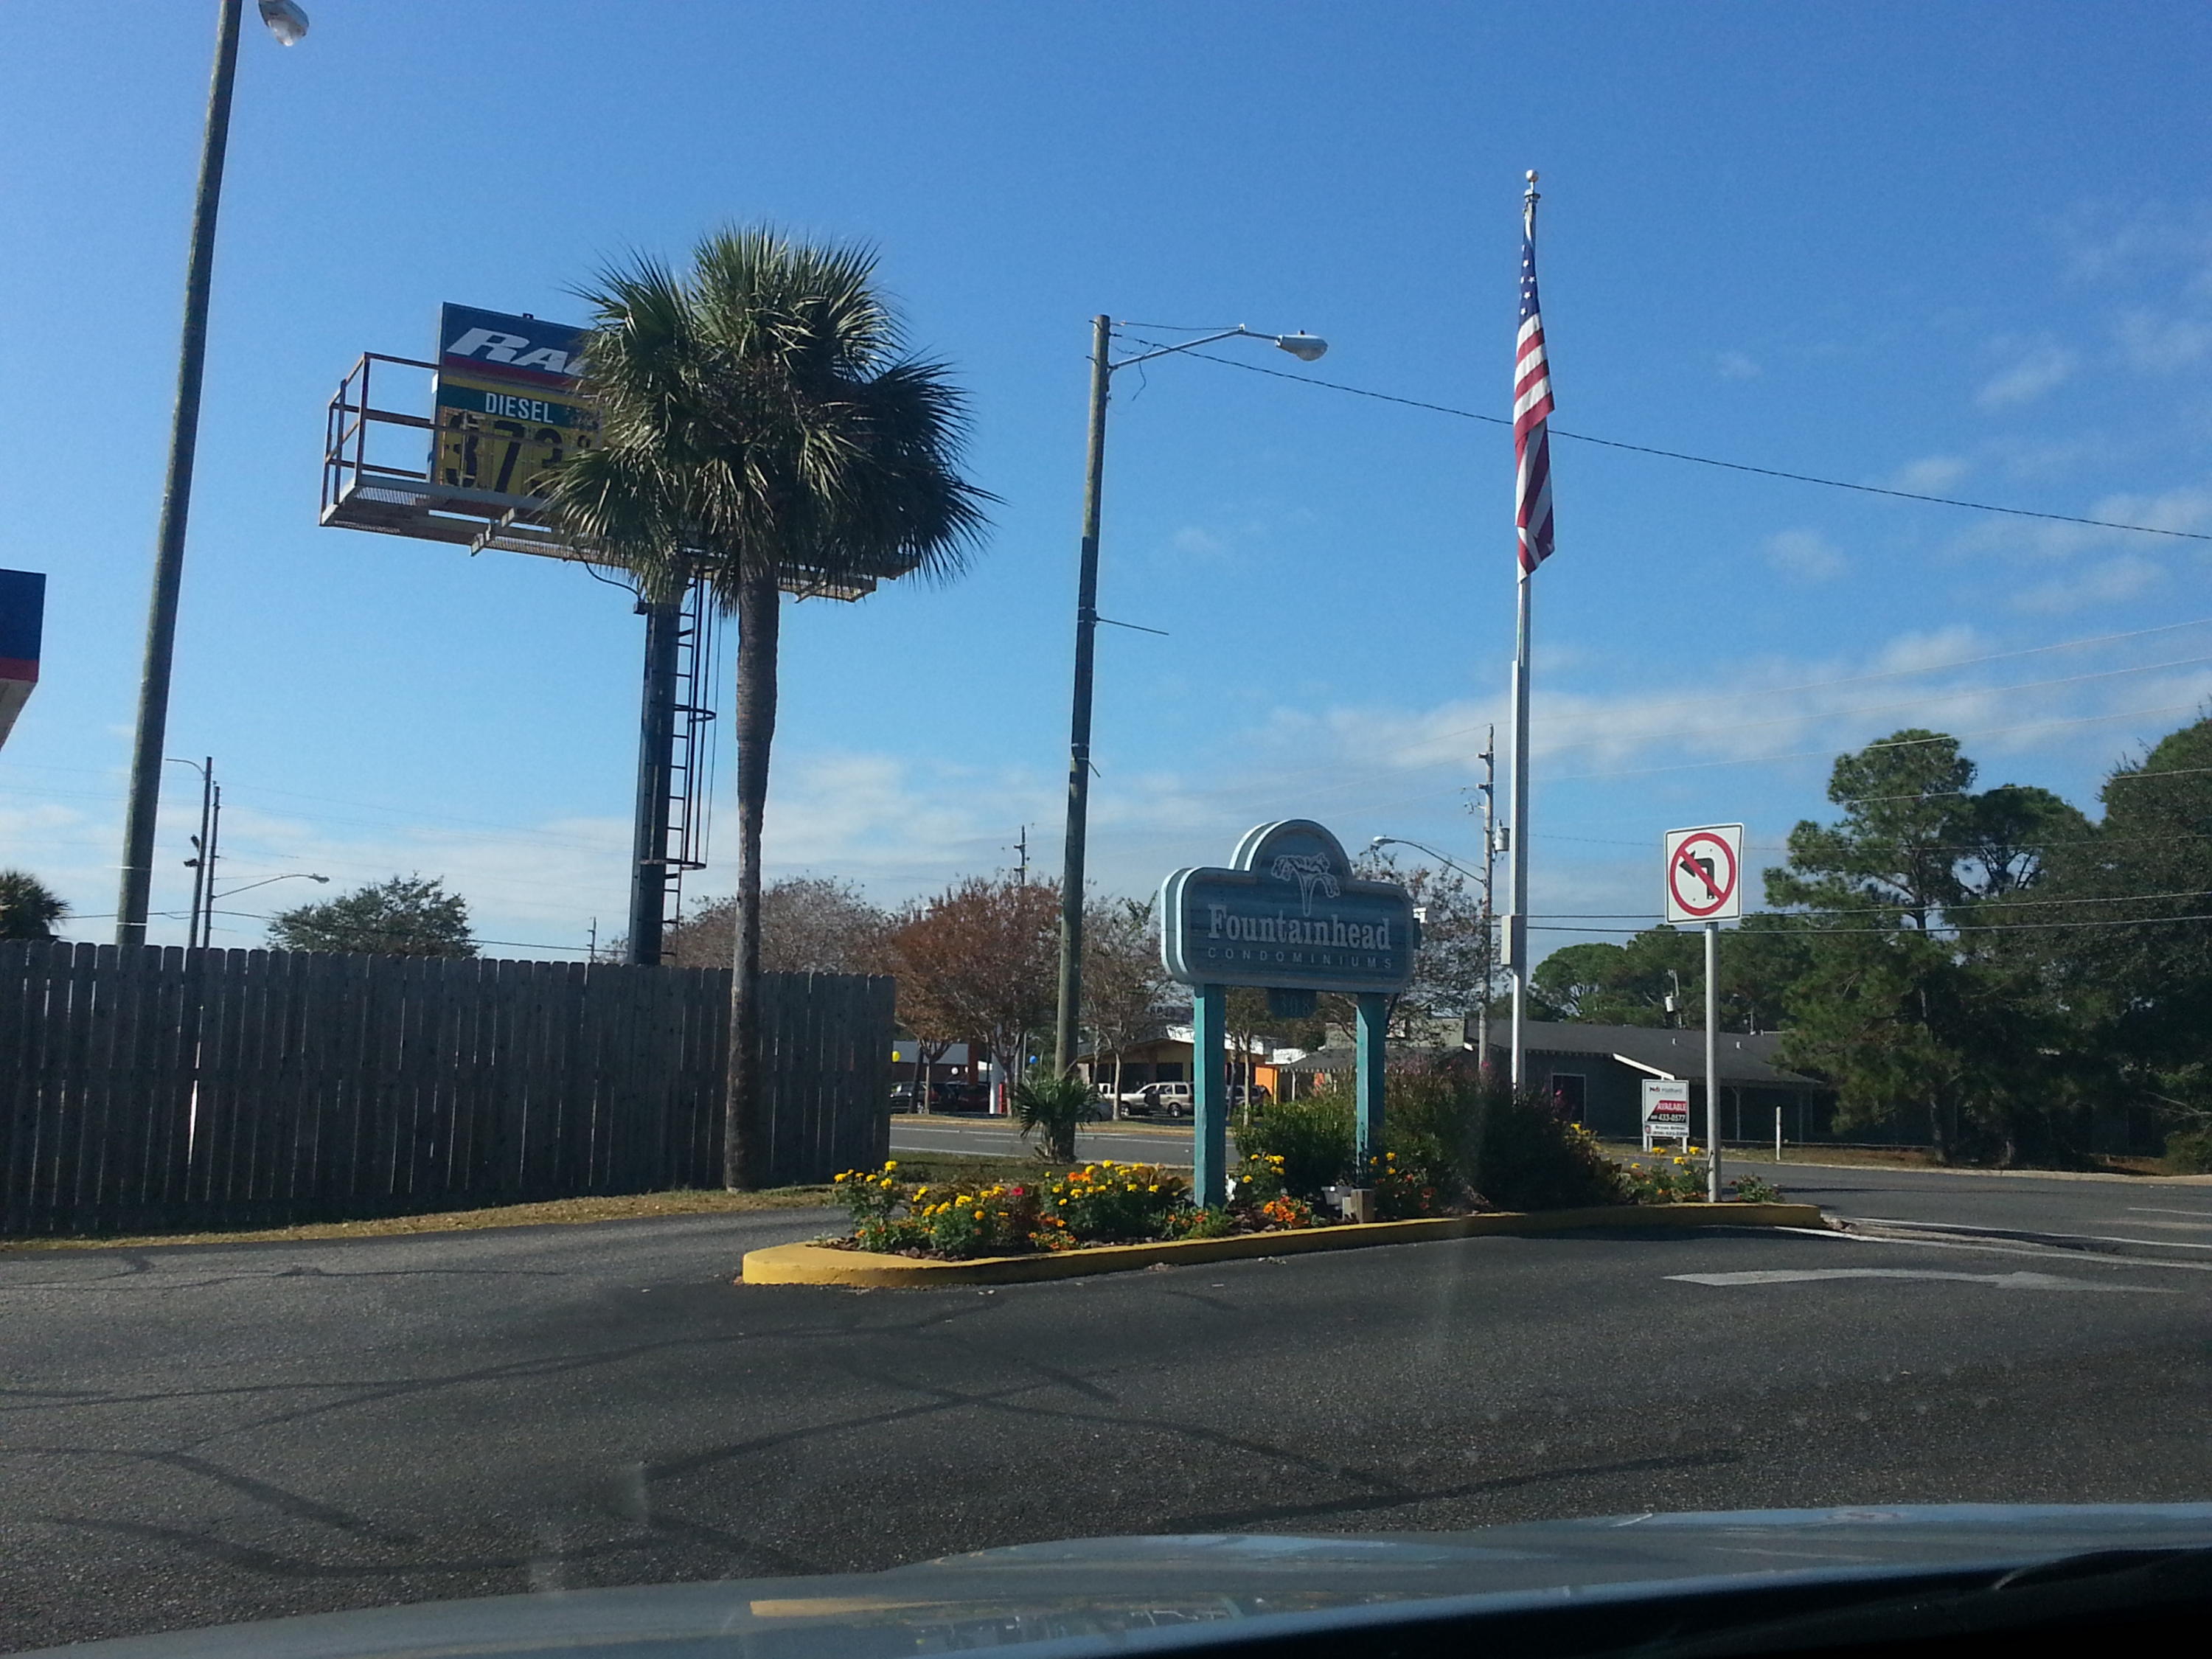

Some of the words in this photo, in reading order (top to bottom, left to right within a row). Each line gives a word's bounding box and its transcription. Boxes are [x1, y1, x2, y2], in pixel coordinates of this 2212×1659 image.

[485, 392, 554, 424] DIESEL
[1208, 904, 1391, 950] Fountainhead
[1208, 947, 1391, 969] CONDOMINIUMS
[1657, 1102, 1687, 1111] AVAILABLE
